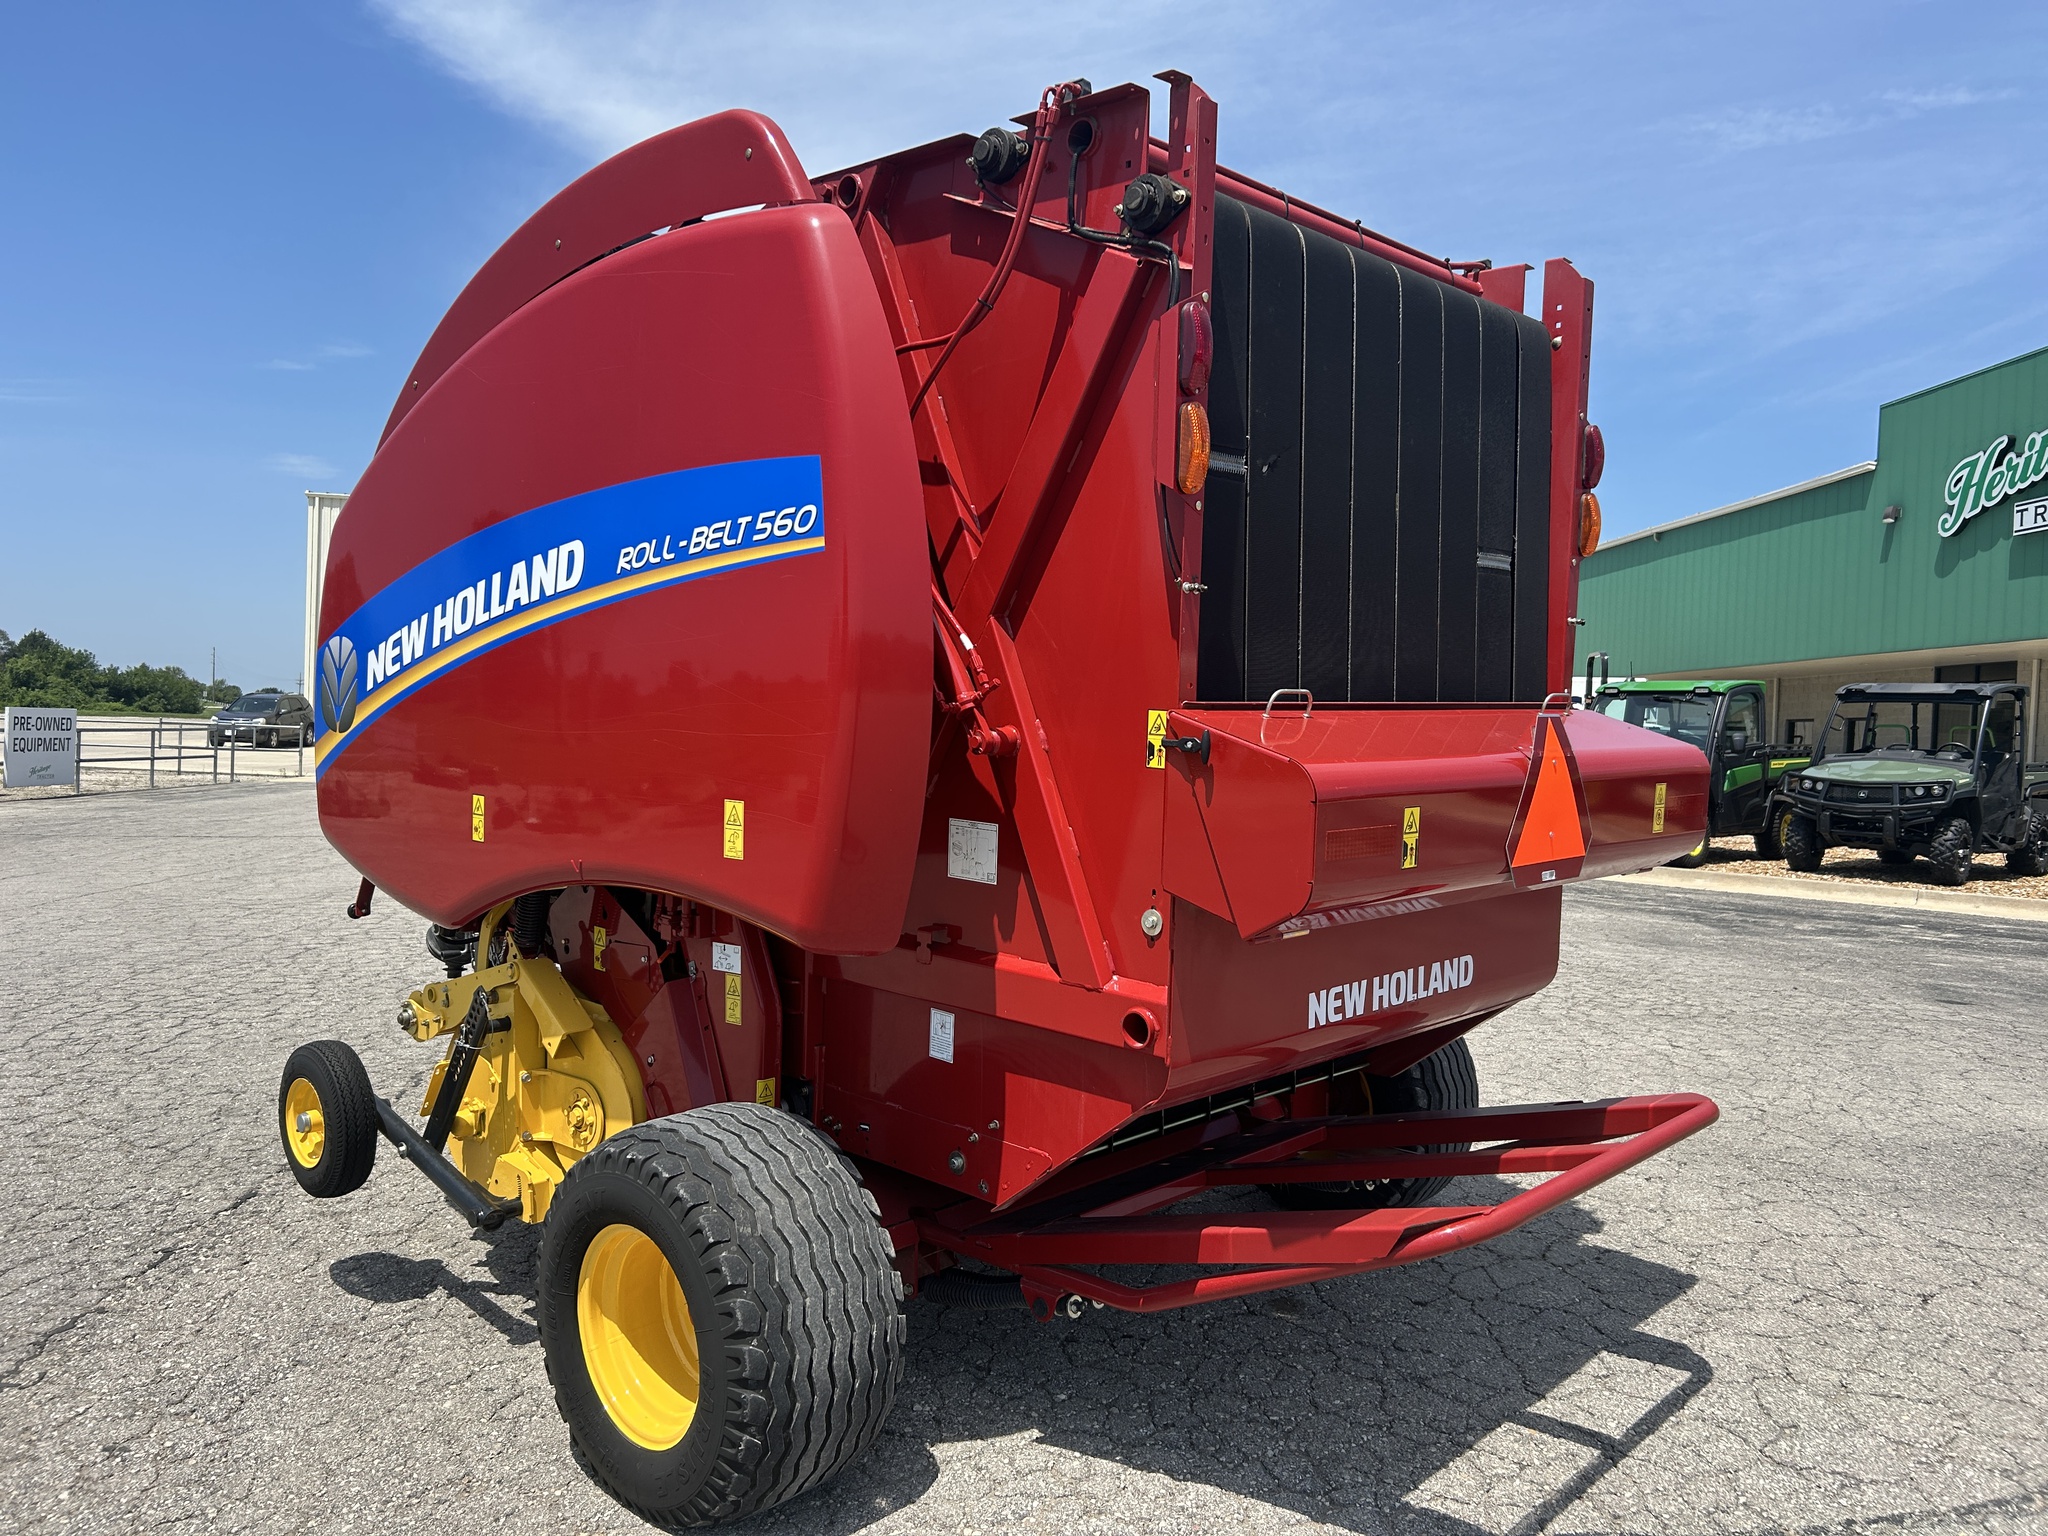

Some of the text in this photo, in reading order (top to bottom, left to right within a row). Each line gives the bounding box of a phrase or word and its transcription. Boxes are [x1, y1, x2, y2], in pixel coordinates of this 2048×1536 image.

[617, 504, 818, 574] ROLL-BELT 560
[366, 539, 586, 691] NEW HOLLAND
[13, 716, 72, 731] PRE-OWNED
[13, 737, 71, 753] EQUIPMENT
[1308, 954, 1474, 1029] NEW HOLLAND
